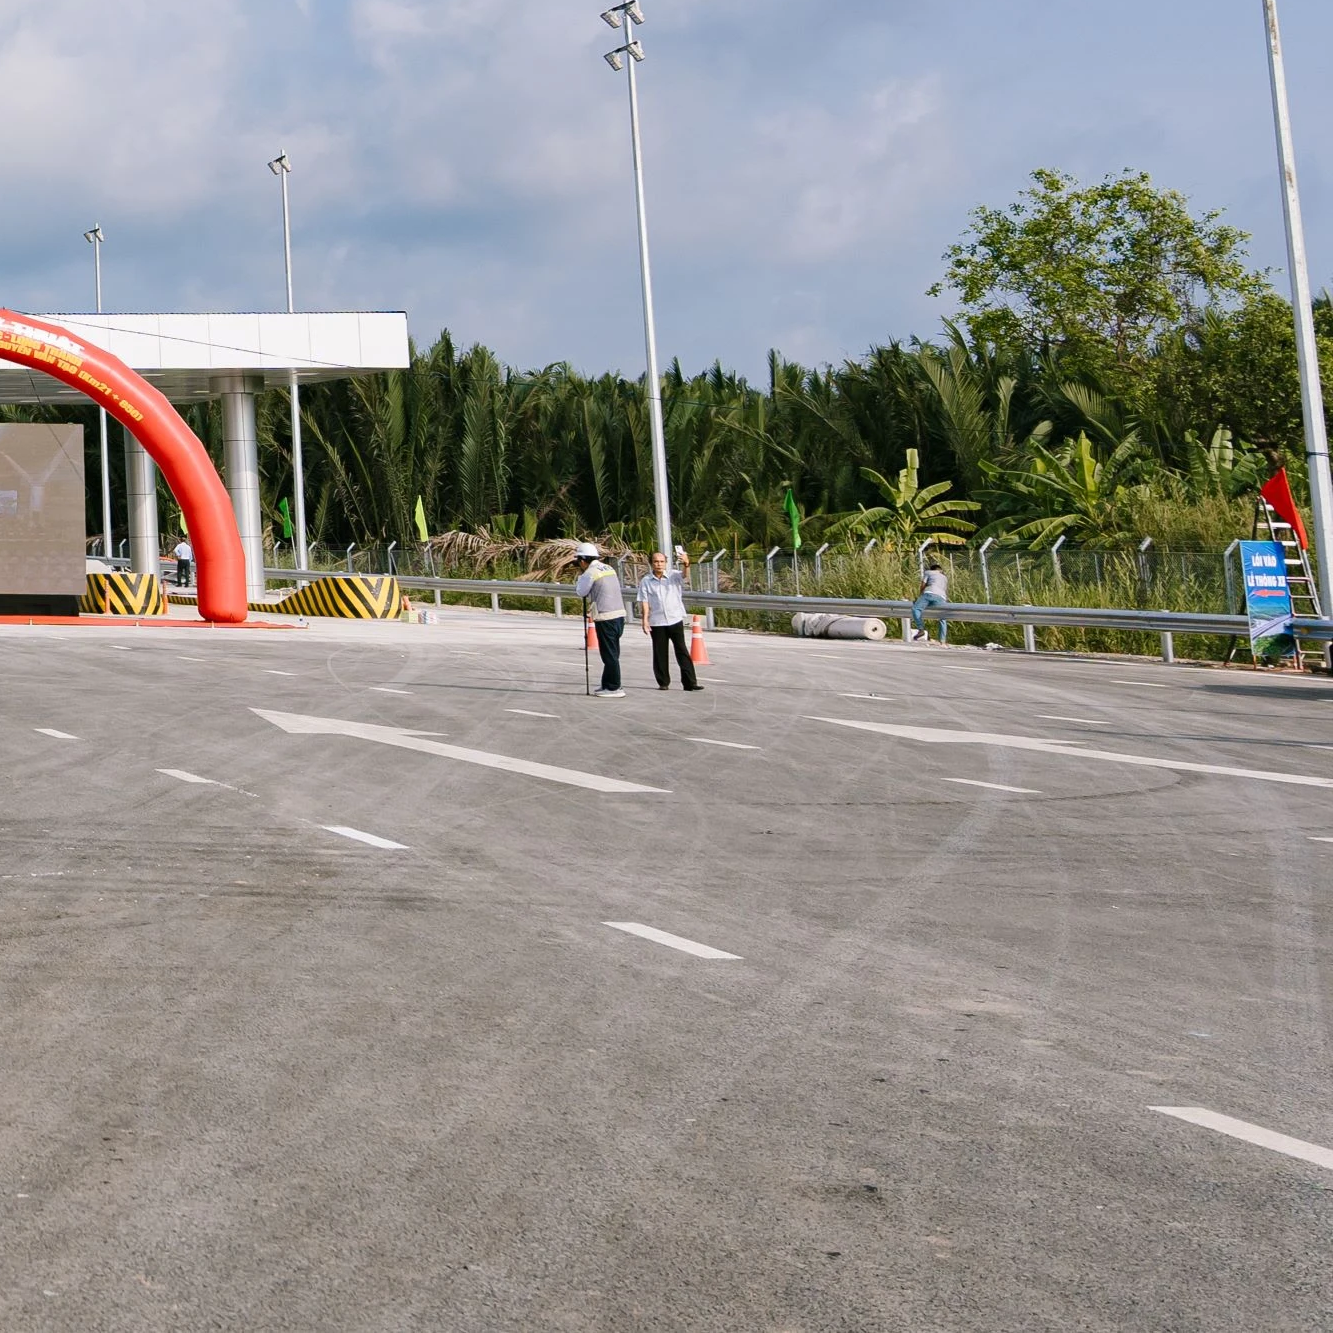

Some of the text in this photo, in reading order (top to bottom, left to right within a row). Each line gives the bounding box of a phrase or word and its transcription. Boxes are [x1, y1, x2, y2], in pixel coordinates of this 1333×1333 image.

[11, 321, 85, 354] THUẬT
[1252, 552, 1277, 567] LỐI VÀO
[1247, 570, 1255, 587] LỄ
[1255, 573, 1277, 587] THÔNG
